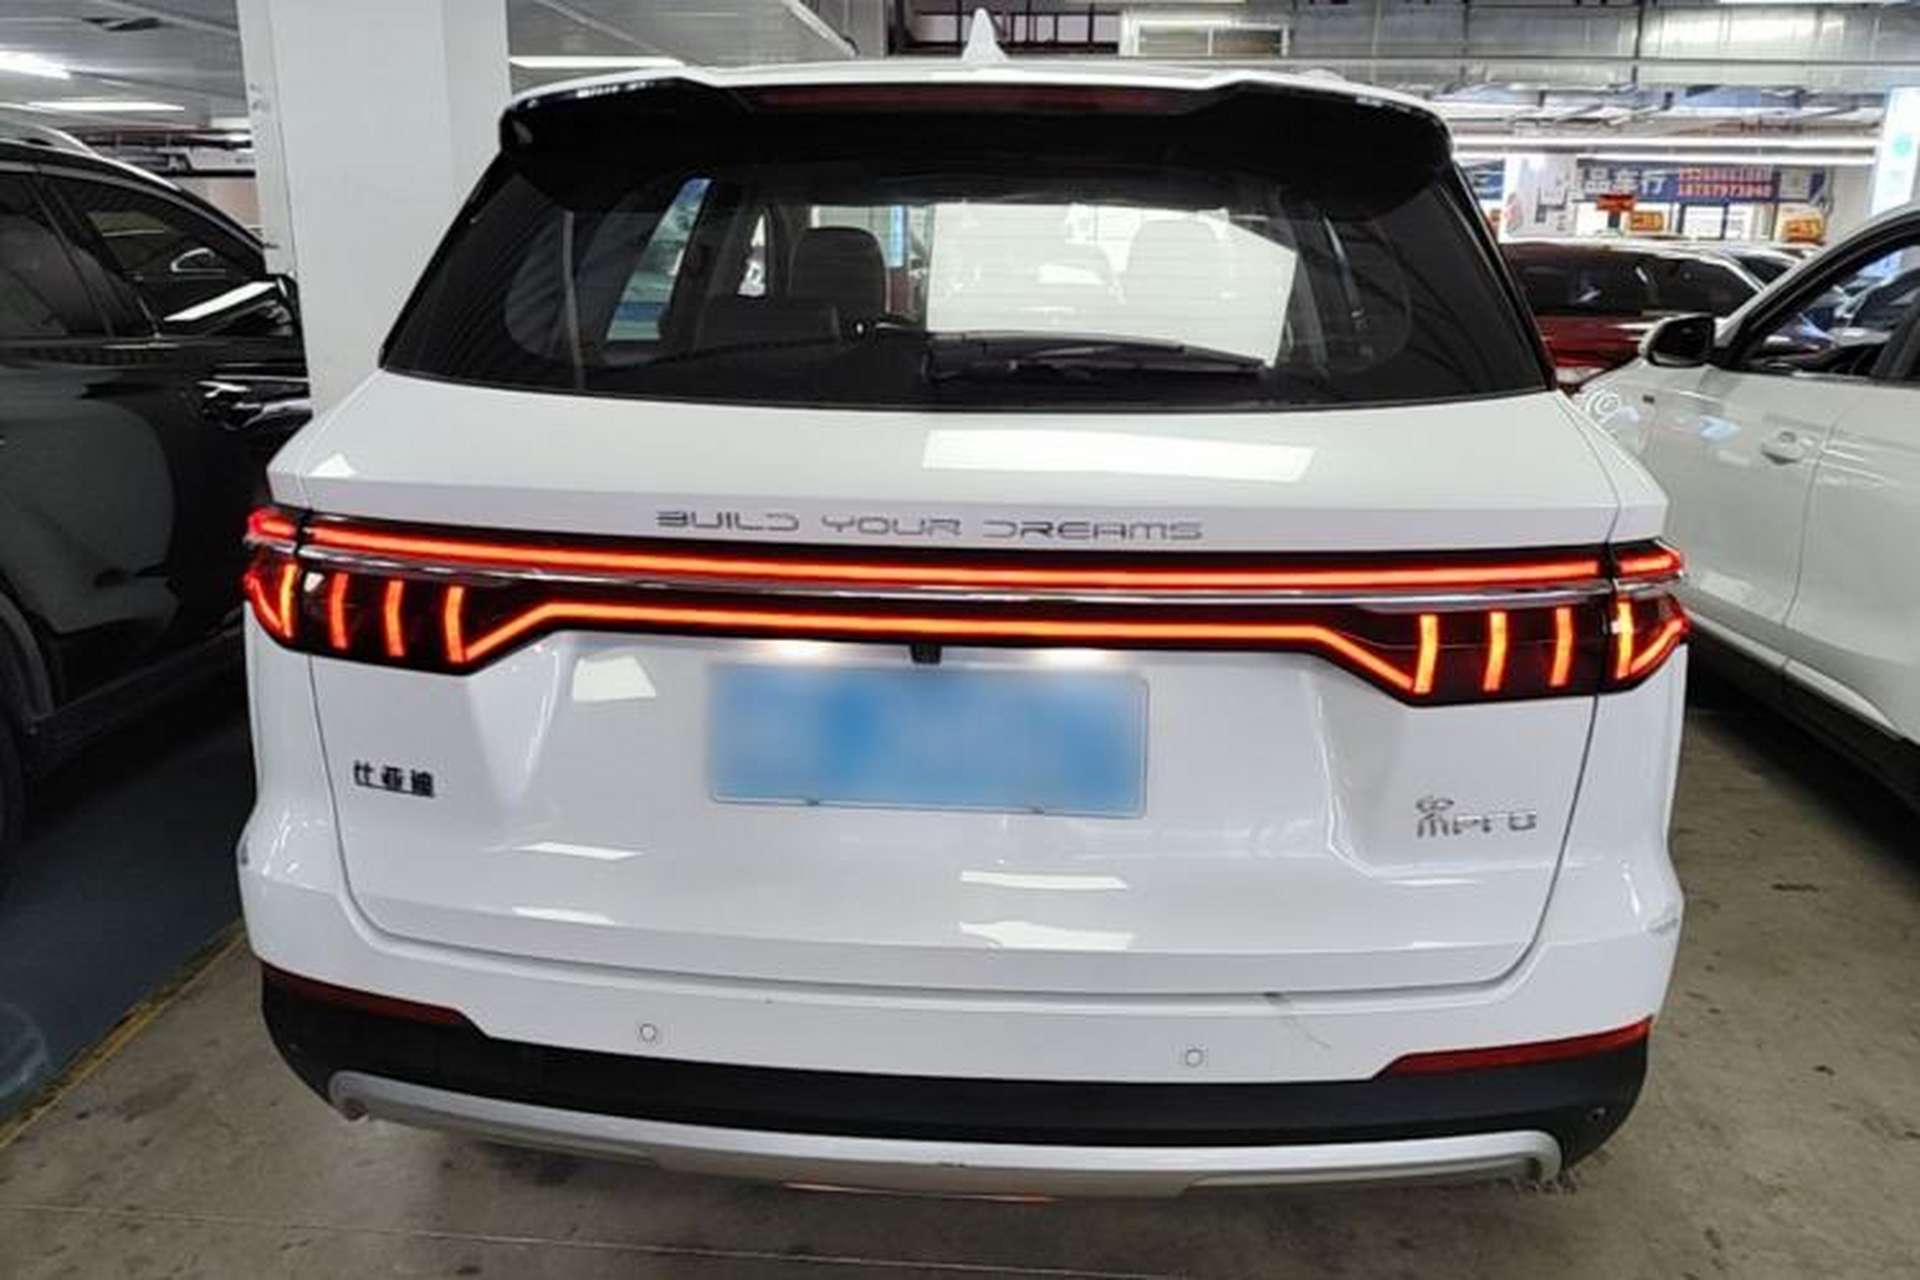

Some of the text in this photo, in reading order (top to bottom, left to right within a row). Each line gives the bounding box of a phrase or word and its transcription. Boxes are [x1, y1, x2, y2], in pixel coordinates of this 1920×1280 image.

[656, 510, 1203, 541] BUILD YOUR DREAMS
[354, 760, 435, 798] 比亚迪
